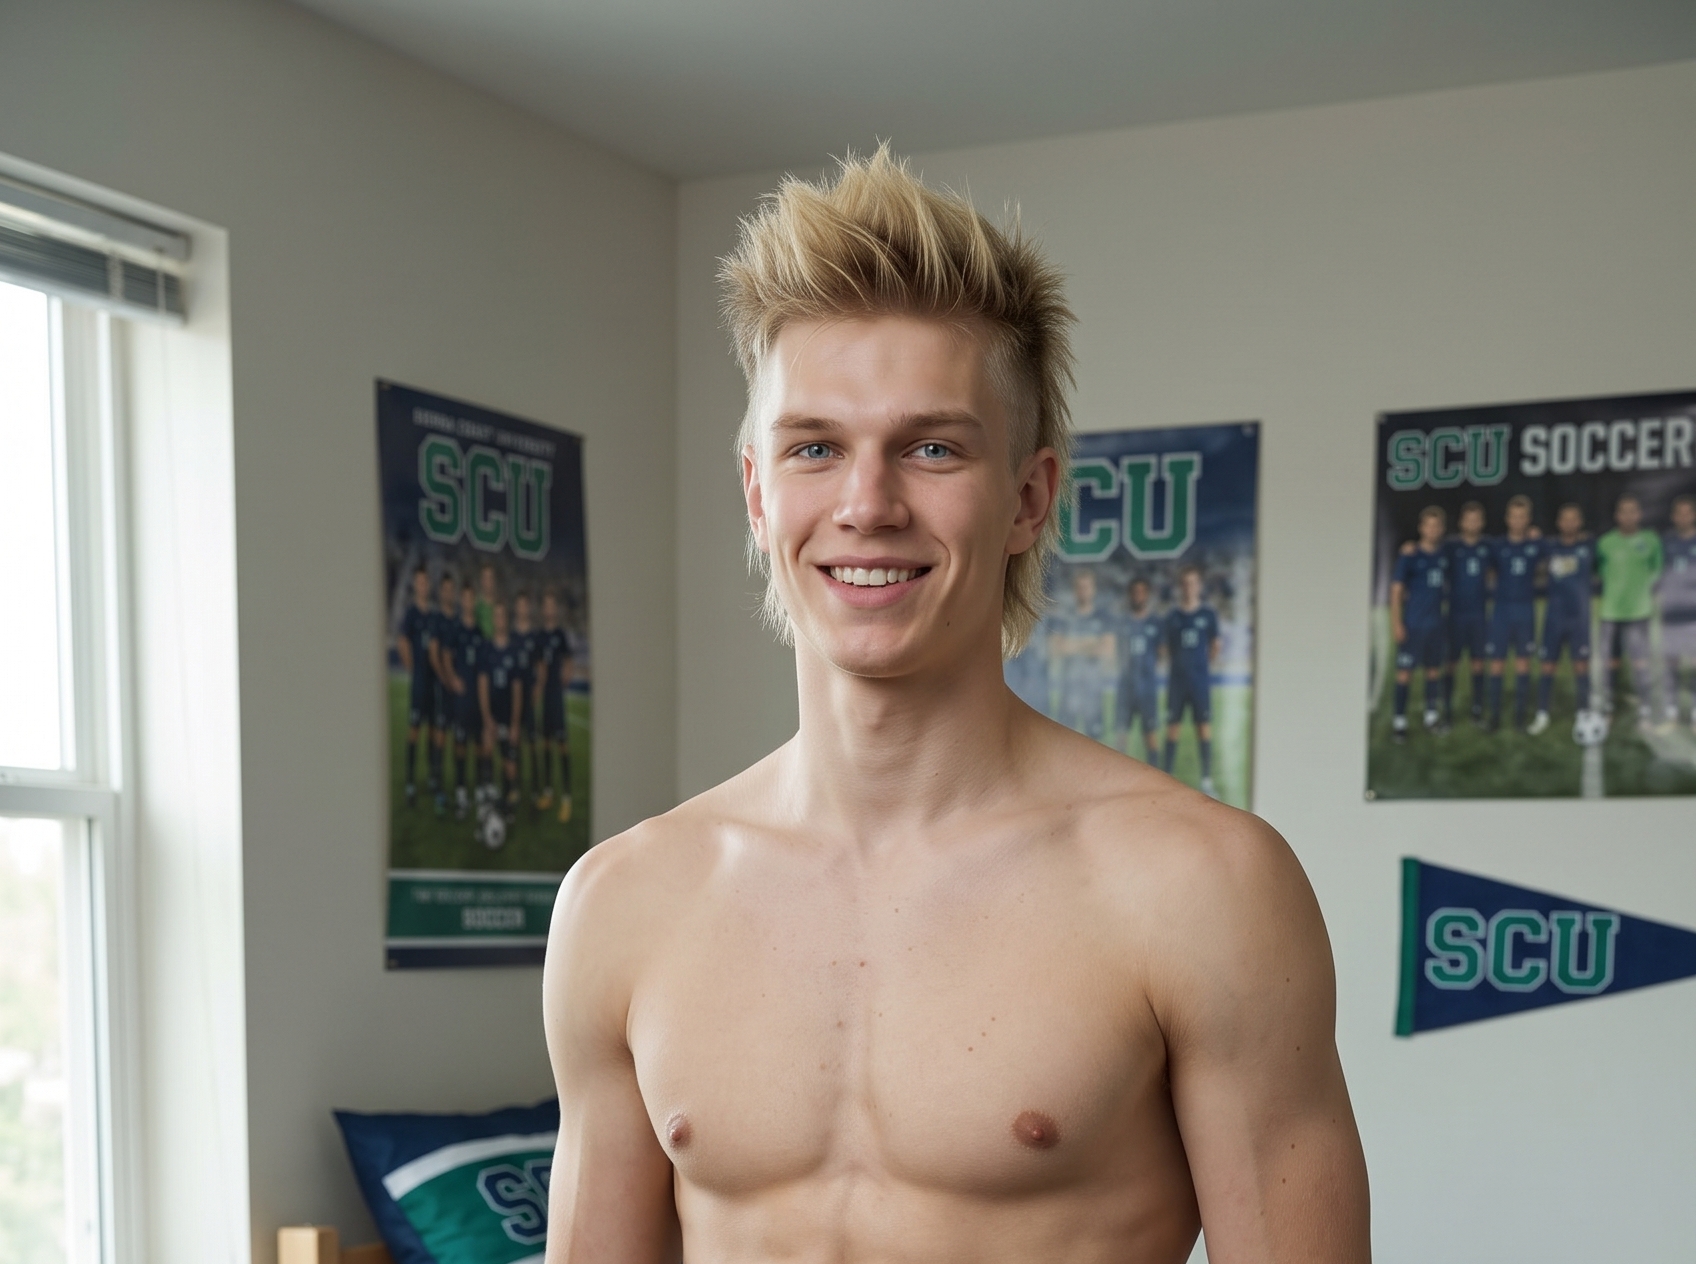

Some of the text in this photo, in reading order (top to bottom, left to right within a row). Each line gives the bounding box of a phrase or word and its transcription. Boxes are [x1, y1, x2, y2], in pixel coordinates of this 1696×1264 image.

[418, 433, 553, 562] SCU
[1386, 414, 1695, 491] SCU SOCCER
[1057, 453, 1202, 563] CU
[1425, 907, 1620, 994] SCU
